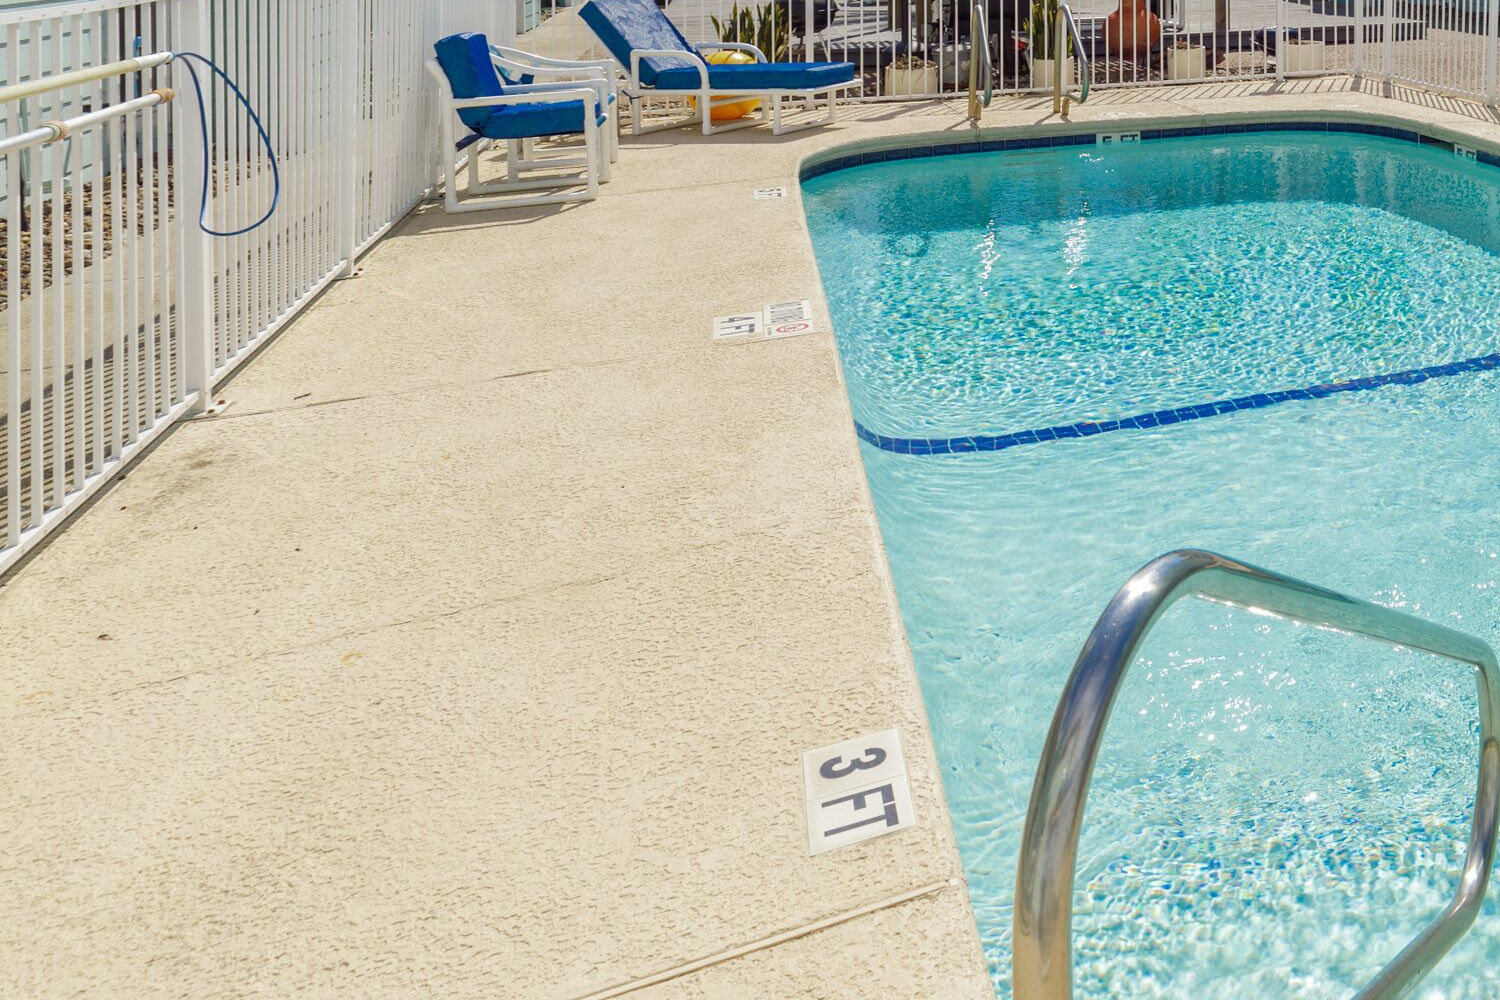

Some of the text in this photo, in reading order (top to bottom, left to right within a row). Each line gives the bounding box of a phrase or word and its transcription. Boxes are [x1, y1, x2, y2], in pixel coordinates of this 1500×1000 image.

[719, 316, 755, 337] 4 FT
[819, 747, 900, 838] 3 FT
